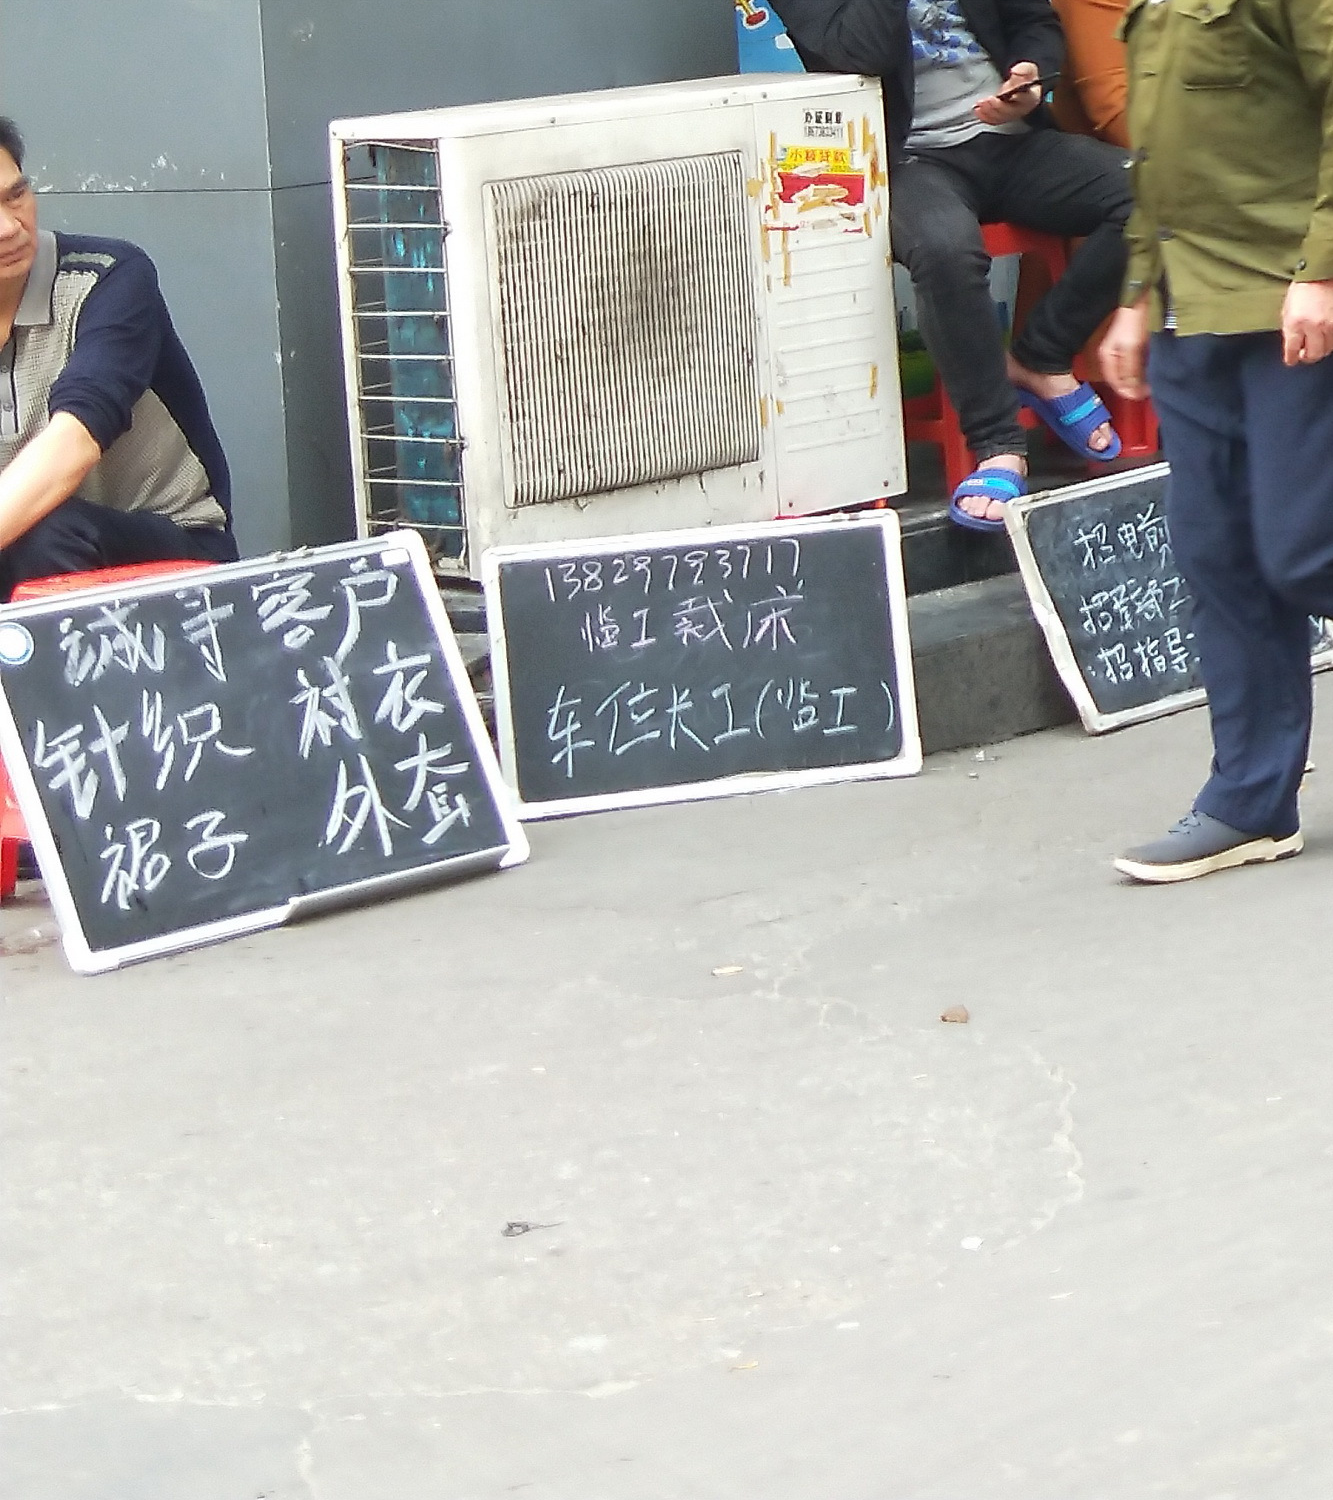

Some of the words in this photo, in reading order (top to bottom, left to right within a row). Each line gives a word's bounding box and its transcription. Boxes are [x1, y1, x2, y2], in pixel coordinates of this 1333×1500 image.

[33, 689, 255, 820] 针织
[100, 808, 250, 911] 裙子
[317, 733, 471, 857] 外套
